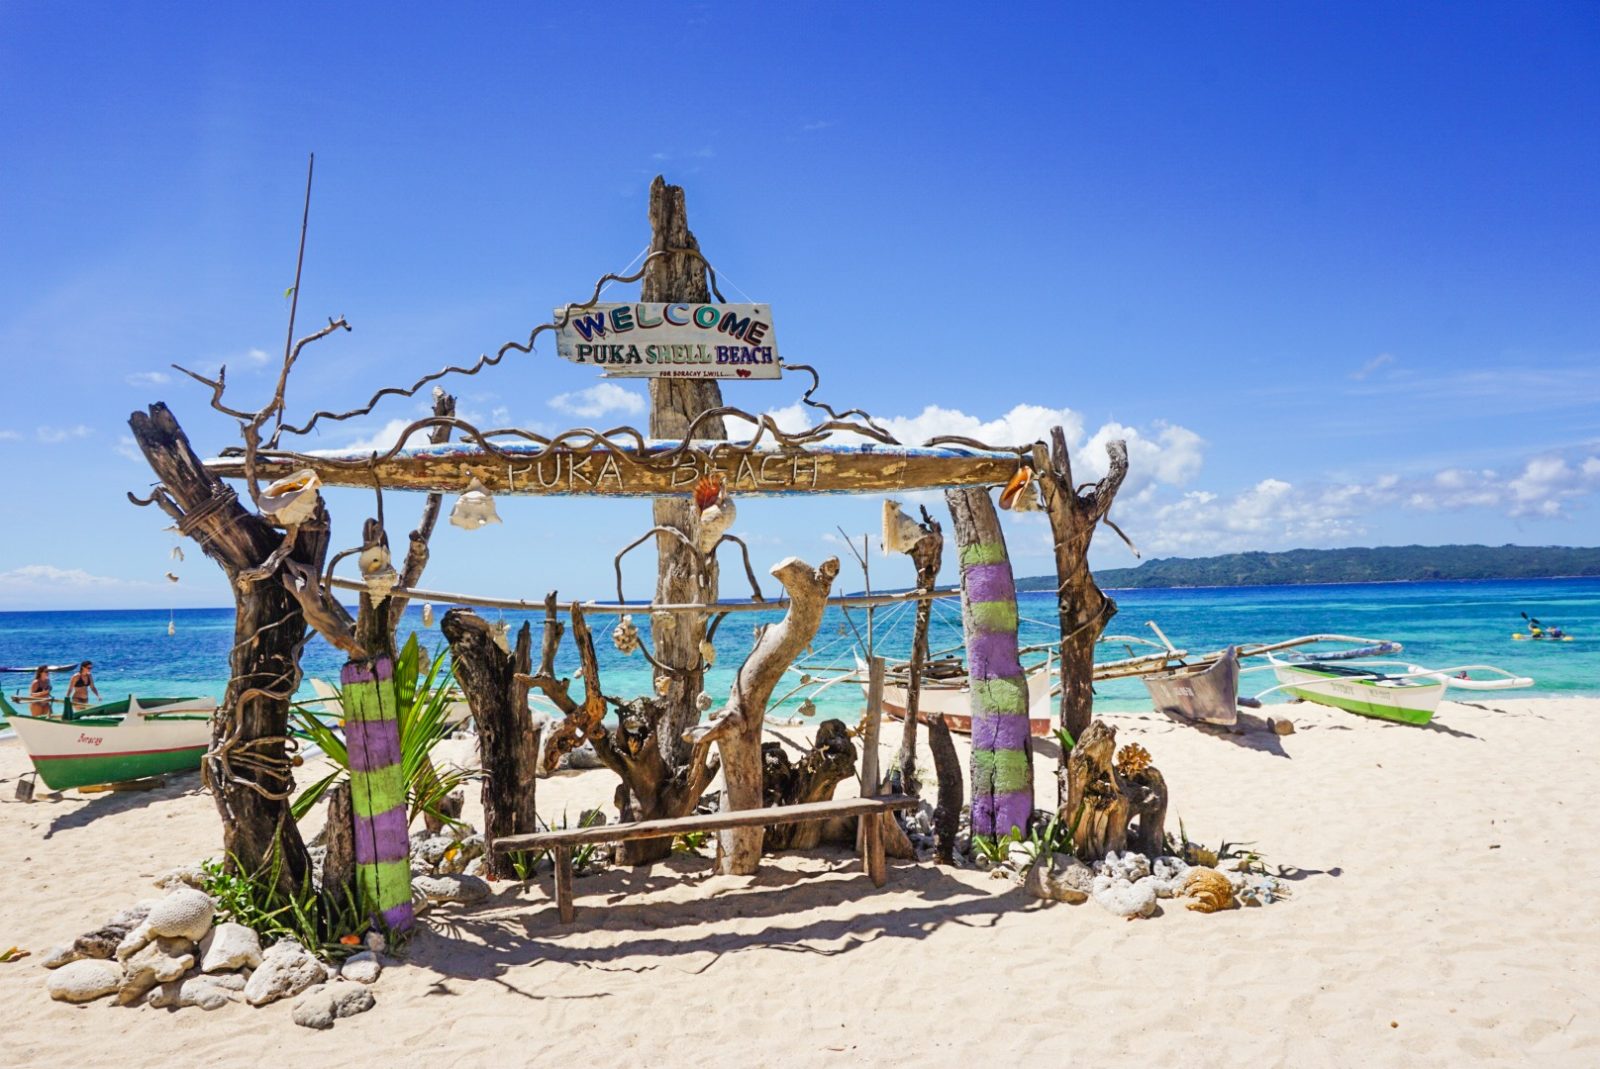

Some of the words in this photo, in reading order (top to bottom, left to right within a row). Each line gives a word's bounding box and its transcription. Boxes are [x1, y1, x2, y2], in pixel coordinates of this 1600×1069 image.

[572, 303, 769, 346] WELCOME
[576, 343, 643, 364] PUKA
[646, 343, 712, 364] SHELL
[716, 345, 773, 365] BEACH
[508, 453, 624, 491] PUKA
